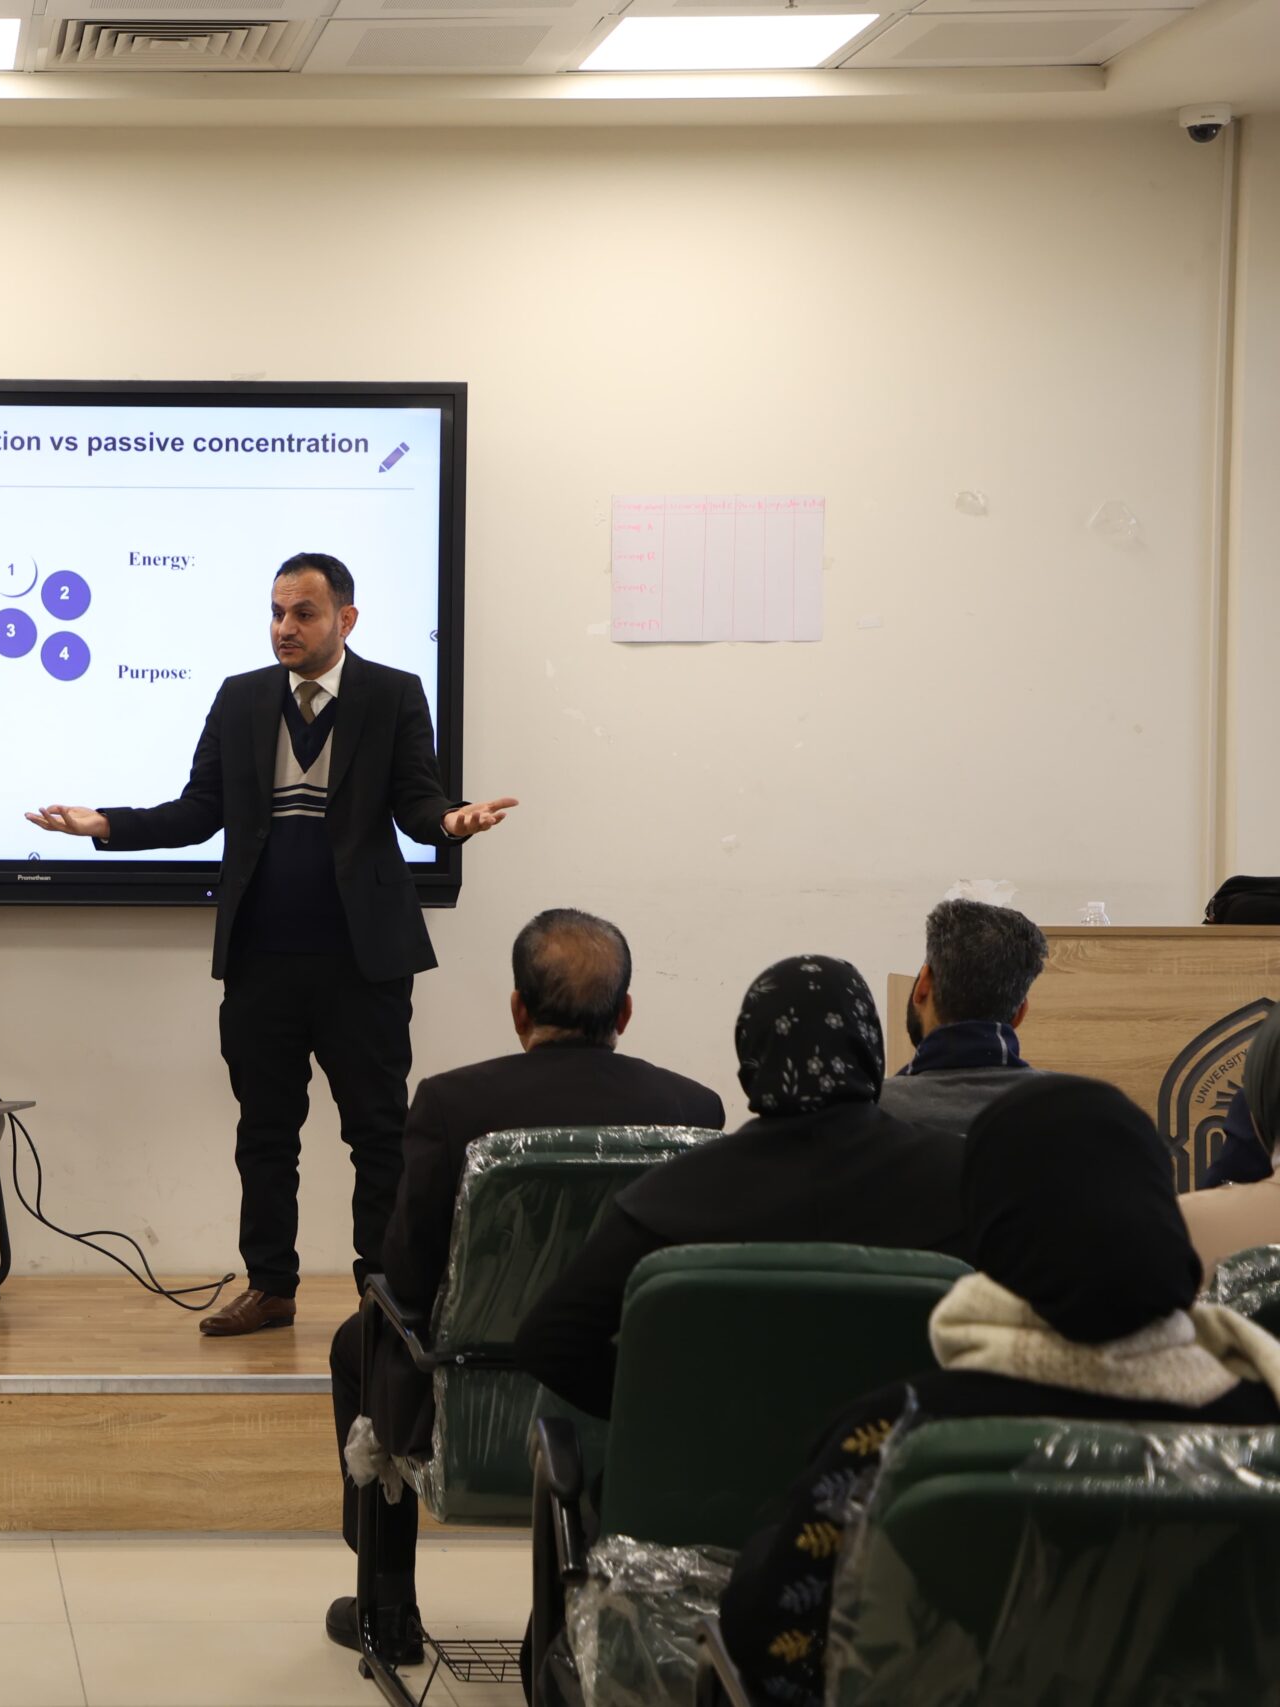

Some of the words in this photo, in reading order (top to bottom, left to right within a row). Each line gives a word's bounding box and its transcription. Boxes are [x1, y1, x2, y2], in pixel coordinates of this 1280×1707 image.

[49, 435, 79, 452] vs
[87, 431, 185, 457] passive
[193, 432, 369, 454] concentration
[128, 551, 196, 571] Energy:
[7, 563, 15, 576] 1
[59, 585, 70, 600] 2
[5, 623, 16, 638] 3
[59, 646, 70, 660] 4
[117, 664, 192, 685] Purpose:
